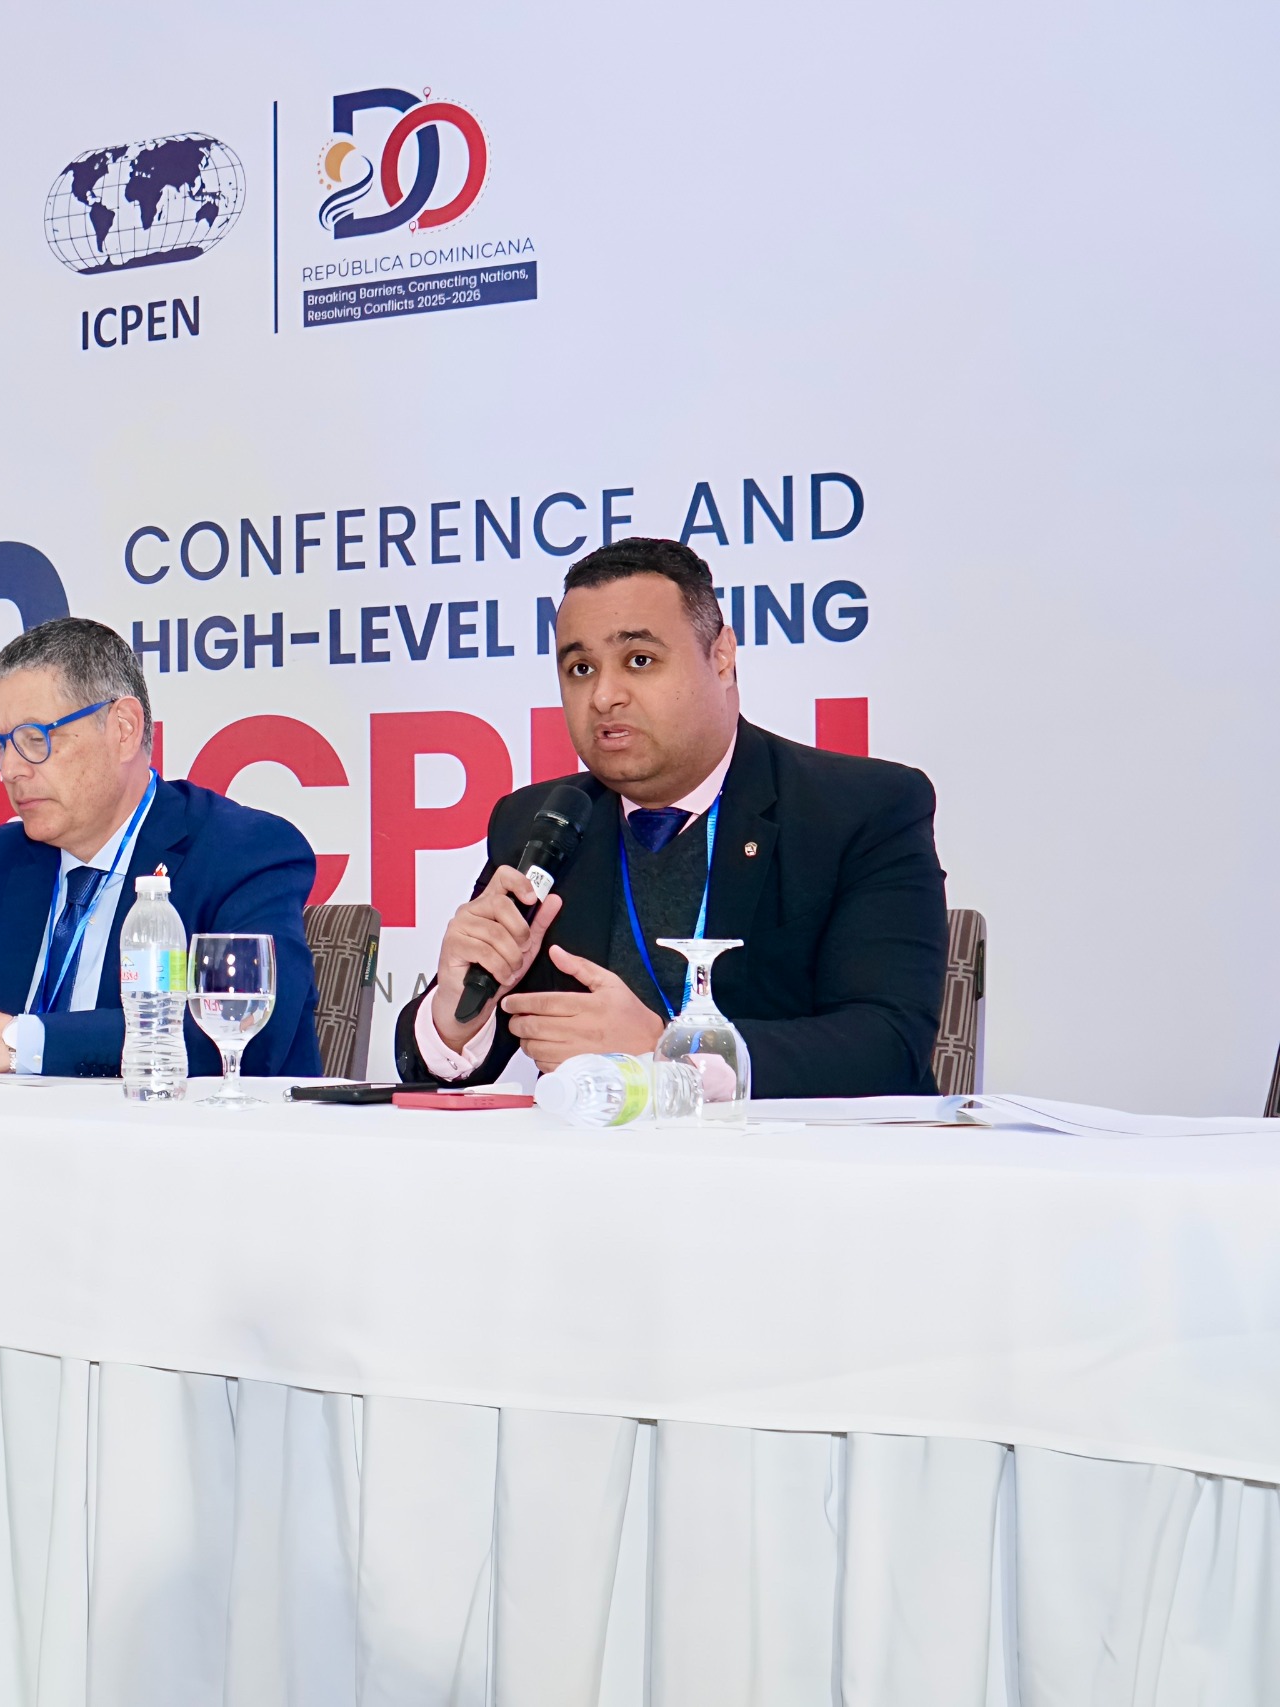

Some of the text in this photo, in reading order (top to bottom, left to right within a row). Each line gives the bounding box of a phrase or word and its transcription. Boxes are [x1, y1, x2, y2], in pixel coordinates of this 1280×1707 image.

[302, 237, 535, 283] REPÚBLICA DOMINICANA
[307, 267, 529, 306] Breaking Barriers, Connecting Nations,
[307, 288, 481, 322] Resolving Conflicts 2025-2026
[81, 295, 200, 350] ICPEN
[124, 471, 865, 585] CONFERENCE AND
[131, 599, 516, 674] HIGH-LEVEL
